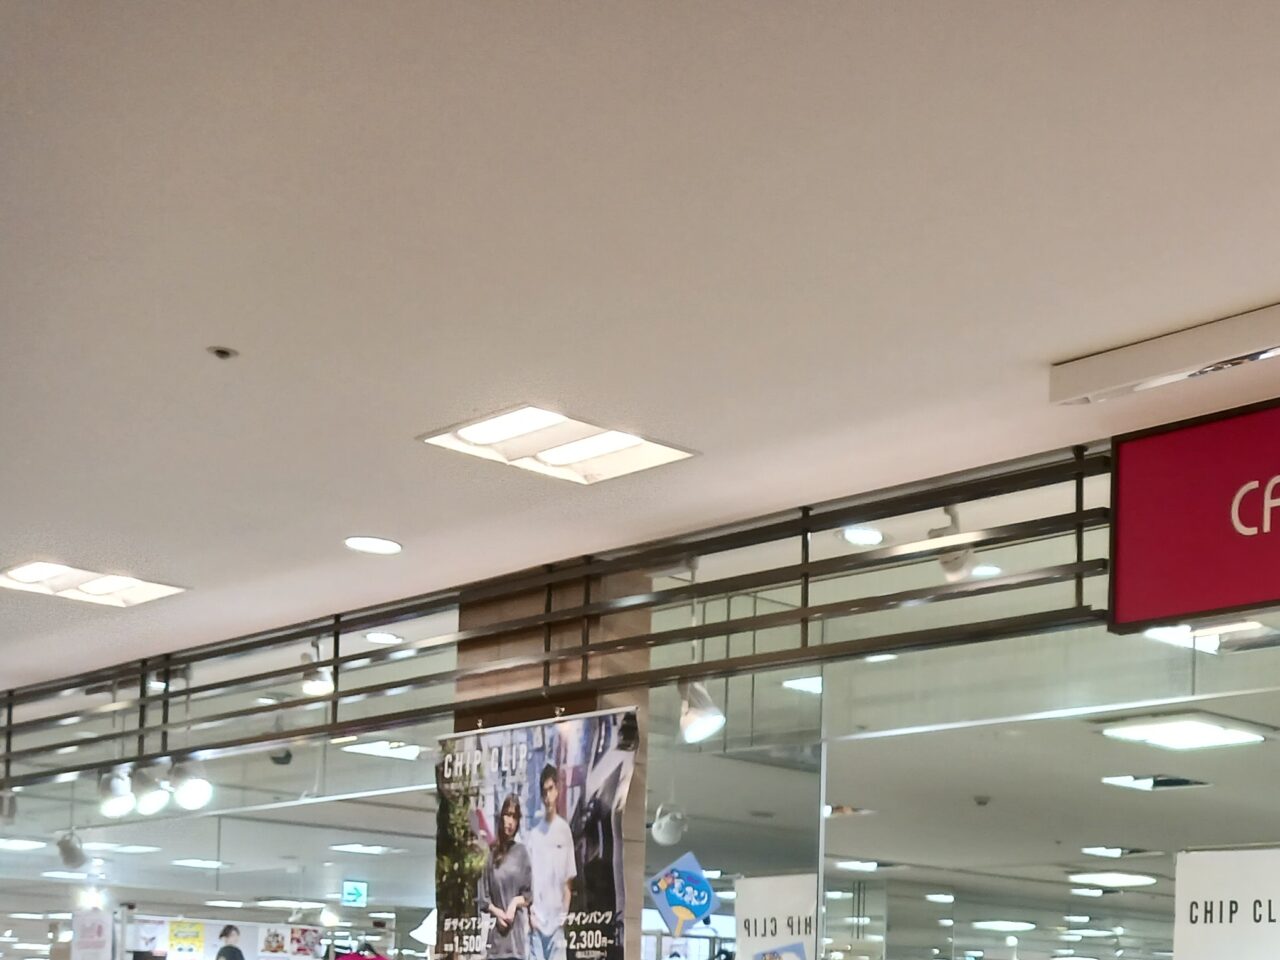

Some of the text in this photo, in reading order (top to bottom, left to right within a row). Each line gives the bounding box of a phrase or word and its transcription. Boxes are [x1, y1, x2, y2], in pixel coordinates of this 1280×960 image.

[443, 744, 528, 779] CHIP CLIP
[444, 916, 497, 931] デザインTシツ
[1189, 900, 1239, 924] CHIP
